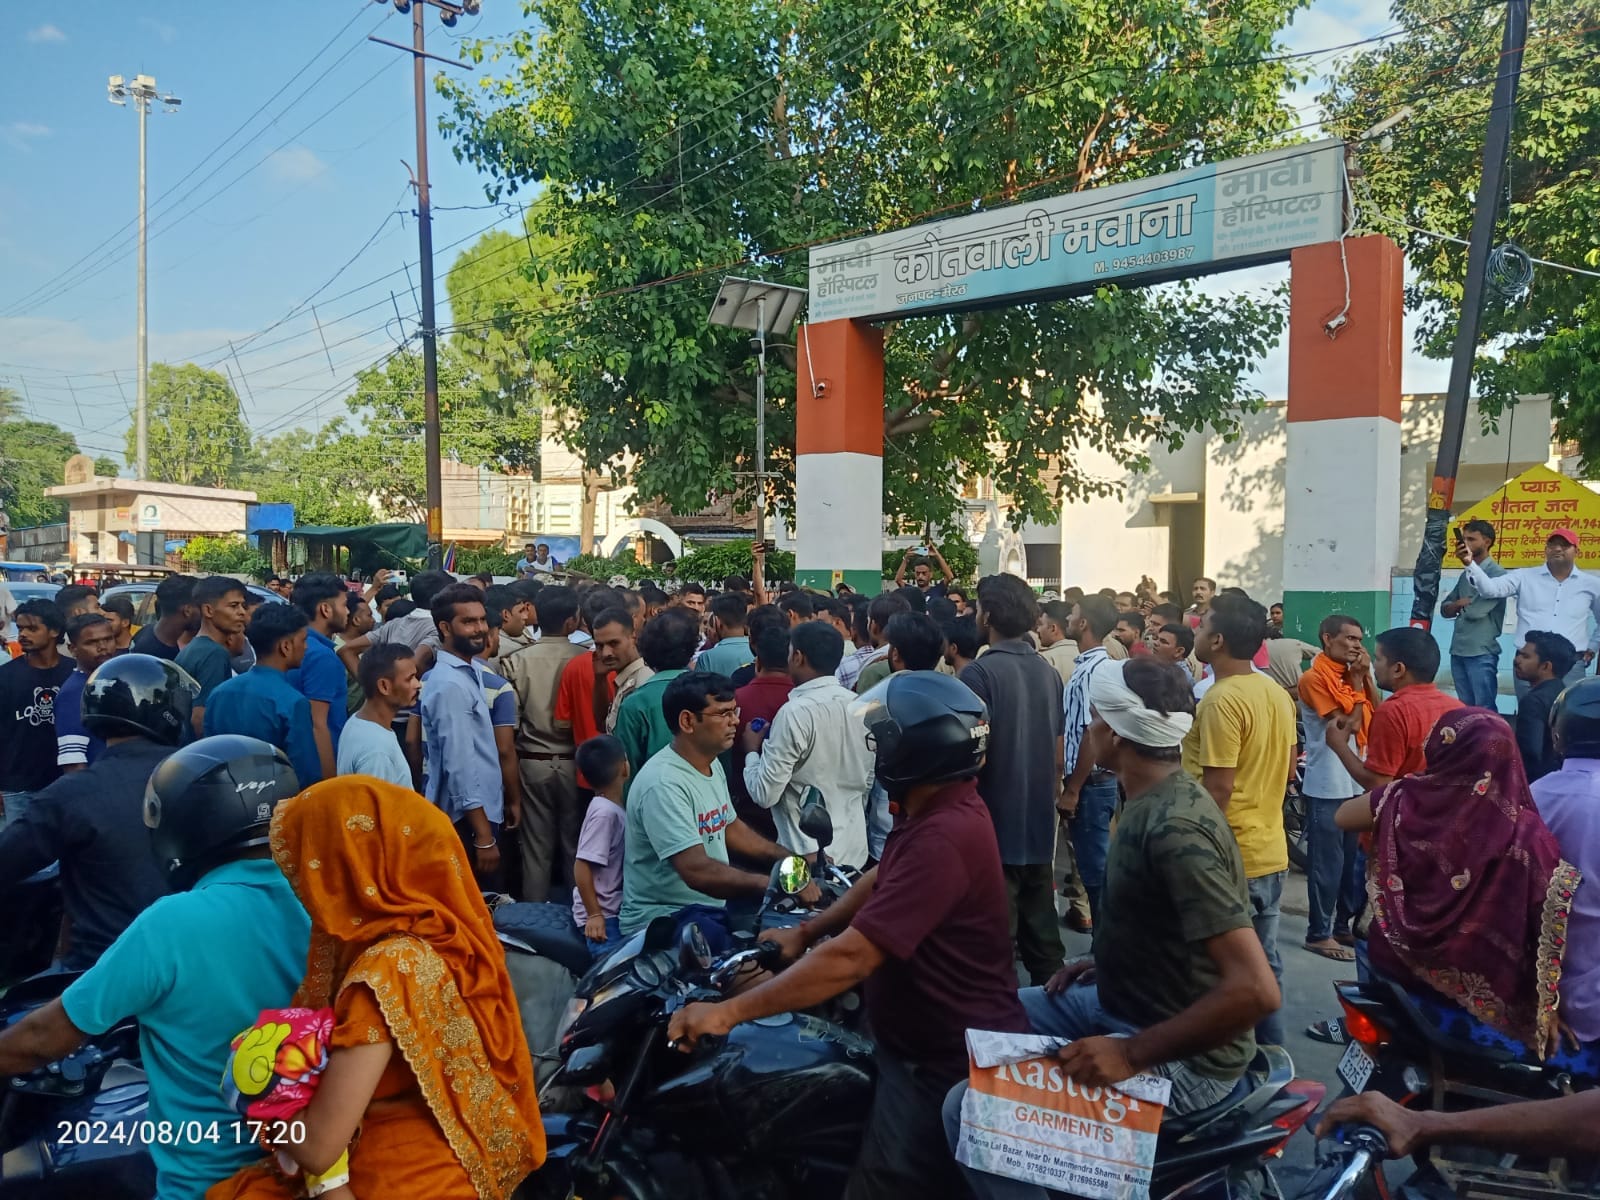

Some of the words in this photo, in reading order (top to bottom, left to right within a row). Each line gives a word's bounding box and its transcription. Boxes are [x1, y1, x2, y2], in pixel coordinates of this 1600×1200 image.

[894, 208, 1055, 284] कोतवाली
[1062, 193, 1198, 254] मवाना
[1093, 261, 1109, 274] M.
[1112, 245, 1195, 271] 9454403987
[1520, 480, 1561, 493] प्याऊ
[1491, 497, 1538, 515] शीतल
[1544, 499, 1579, 512] जल
[1014, 1106, 1115, 1144] GARMENTS
[1025, 1150, 1041, 1161] Near
